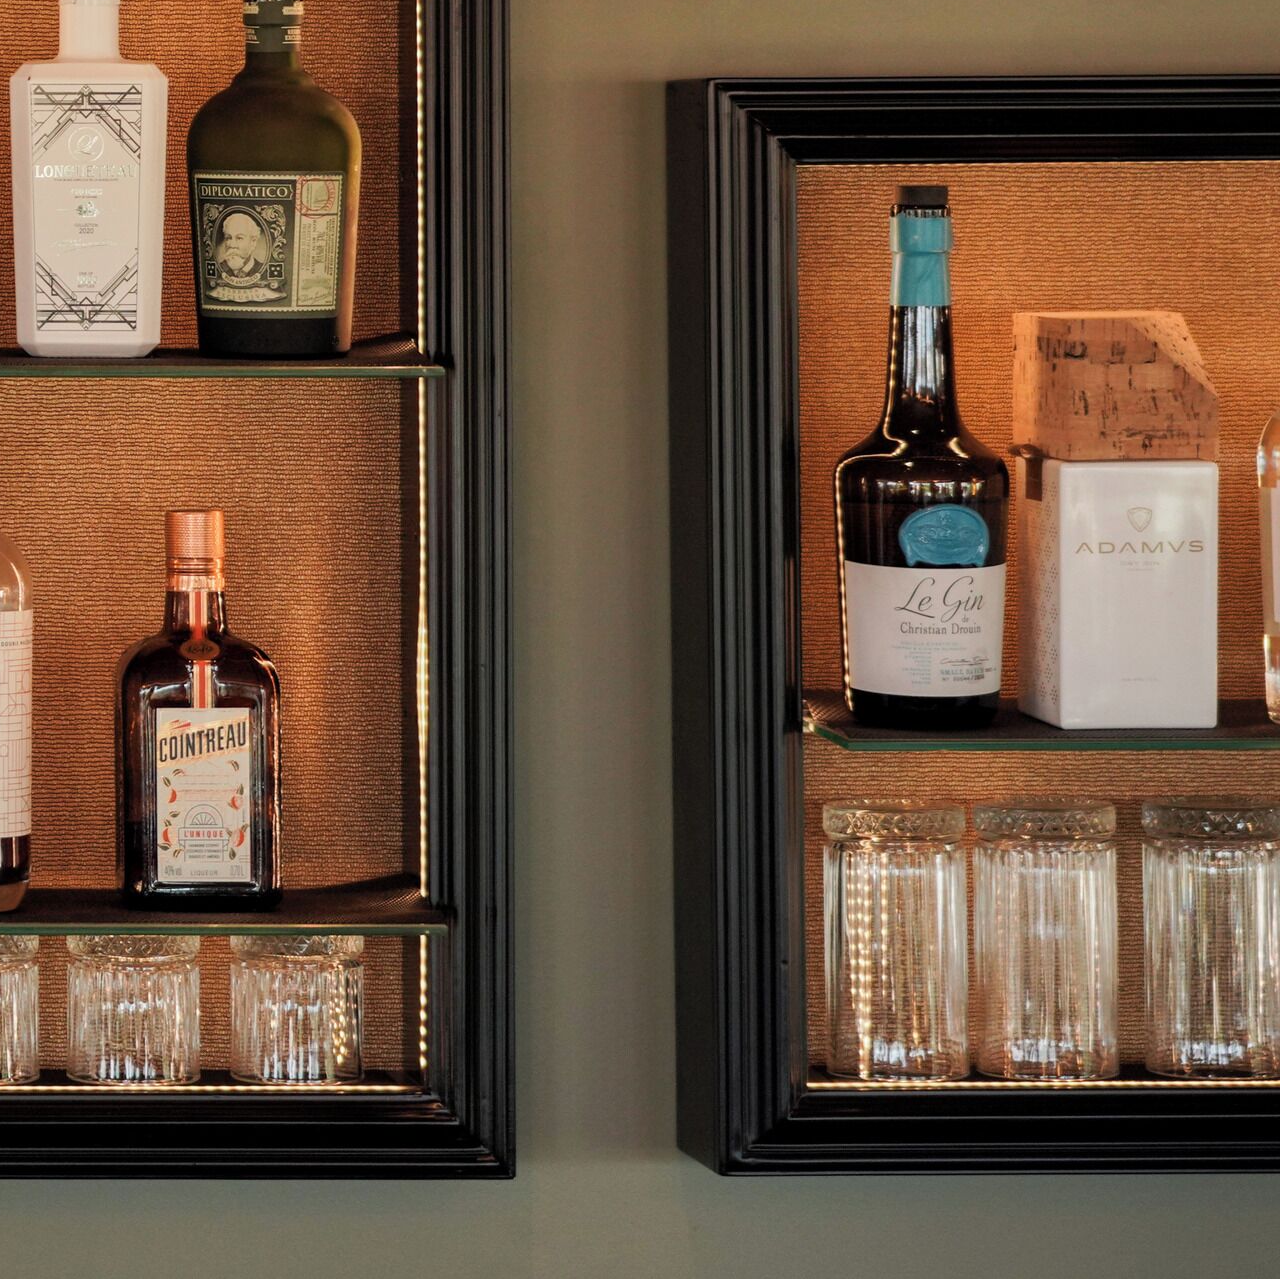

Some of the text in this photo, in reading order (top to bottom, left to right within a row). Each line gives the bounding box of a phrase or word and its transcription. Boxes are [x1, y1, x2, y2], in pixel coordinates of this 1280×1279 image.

[1075, 540, 1204, 554] ADAMVS
[894, 575, 984, 623] Le Gin
[961, 615, 970, 623] de
[900, 621, 982, 635] Christian Drouin
[158, 720, 248, 763] COINTREAU
[184, 830, 224, 838] L'UNIQUE
[190, 869, 219, 877] LIQUEUR
